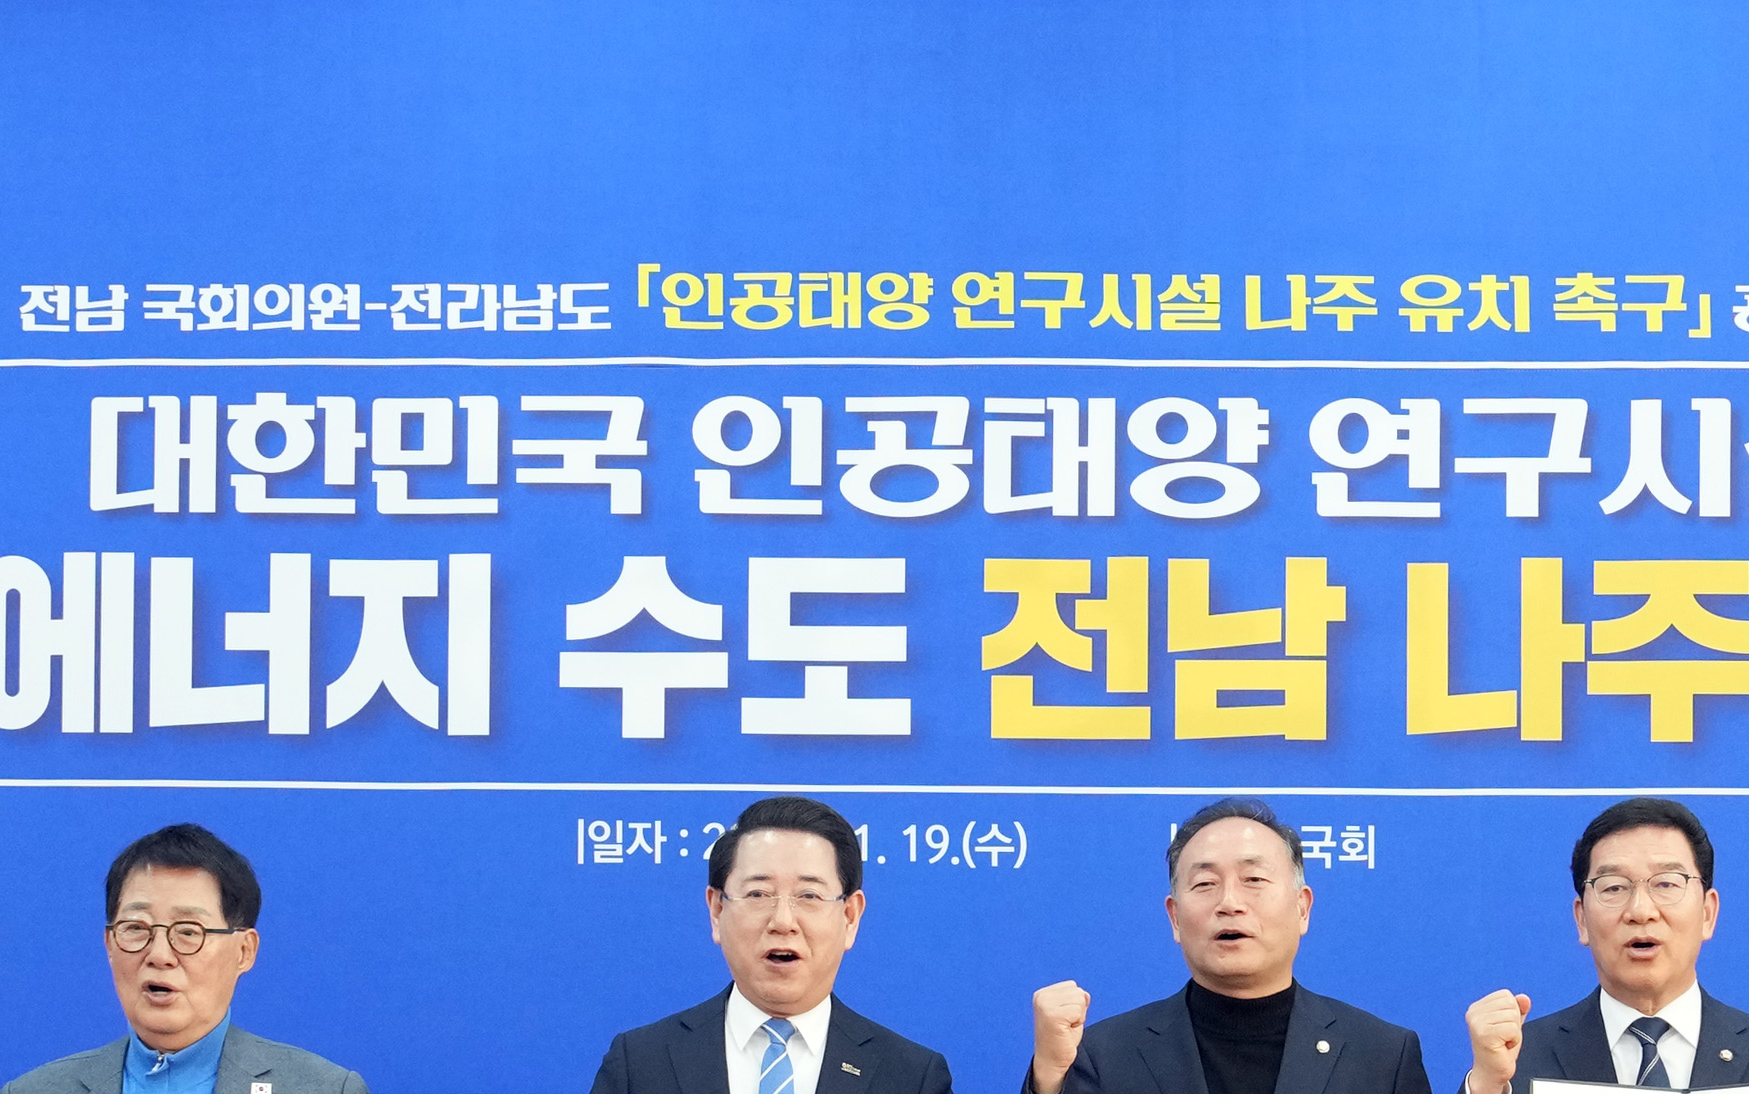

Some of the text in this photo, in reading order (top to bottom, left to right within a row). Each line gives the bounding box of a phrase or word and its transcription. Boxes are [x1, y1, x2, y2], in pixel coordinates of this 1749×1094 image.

[18, 283, 130, 334] 전남
[142, 282, 613, 333] 국회의원-전라남도
[950, 271, 1223, 332] 연구시설
[1243, 274, 1380, 333] 나주
[1397, 274, 1532, 334] 유치
[88, 391, 649, 516] 대한민국
[690, 394, 1271, 520] 인공태양
[557, 555, 913, 740] 수도
[980, 555, 1348, 742] 전남
[902, 820, 1029, 869] 19.(수)
[1303, 824, 1376, 870] 국회
